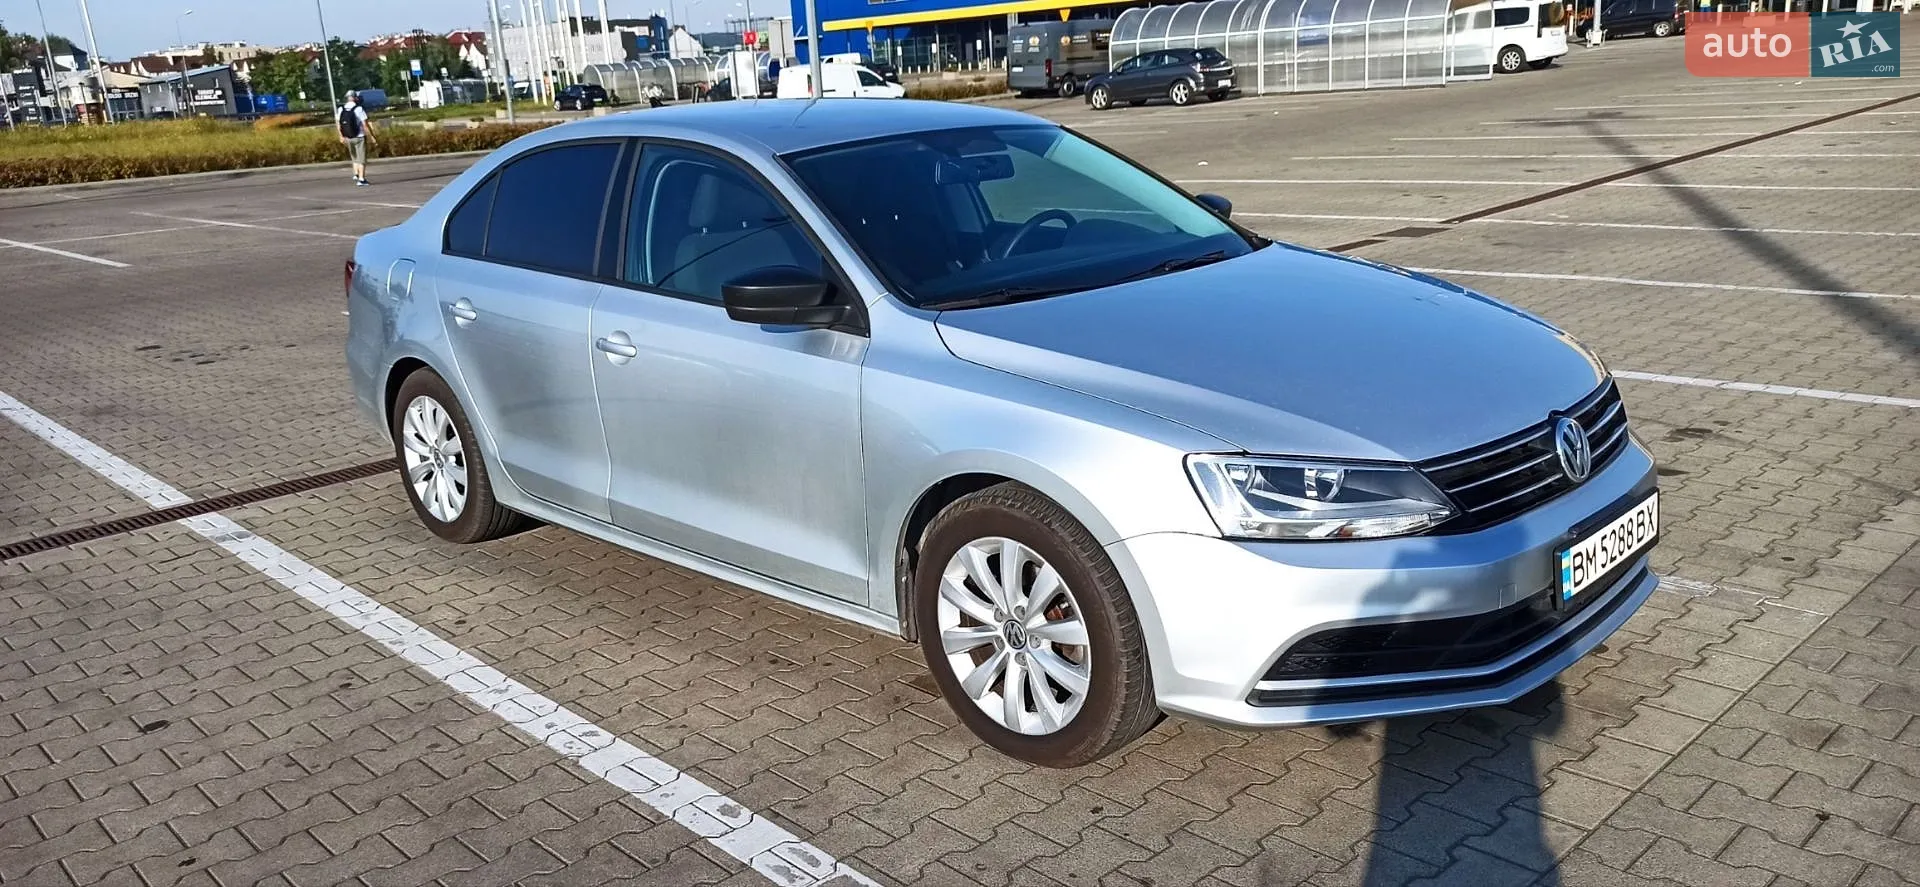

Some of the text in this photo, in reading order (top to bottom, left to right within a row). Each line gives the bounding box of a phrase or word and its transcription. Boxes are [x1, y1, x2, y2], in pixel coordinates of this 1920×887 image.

[1572, 501, 1656, 588] BM 5288 BX
